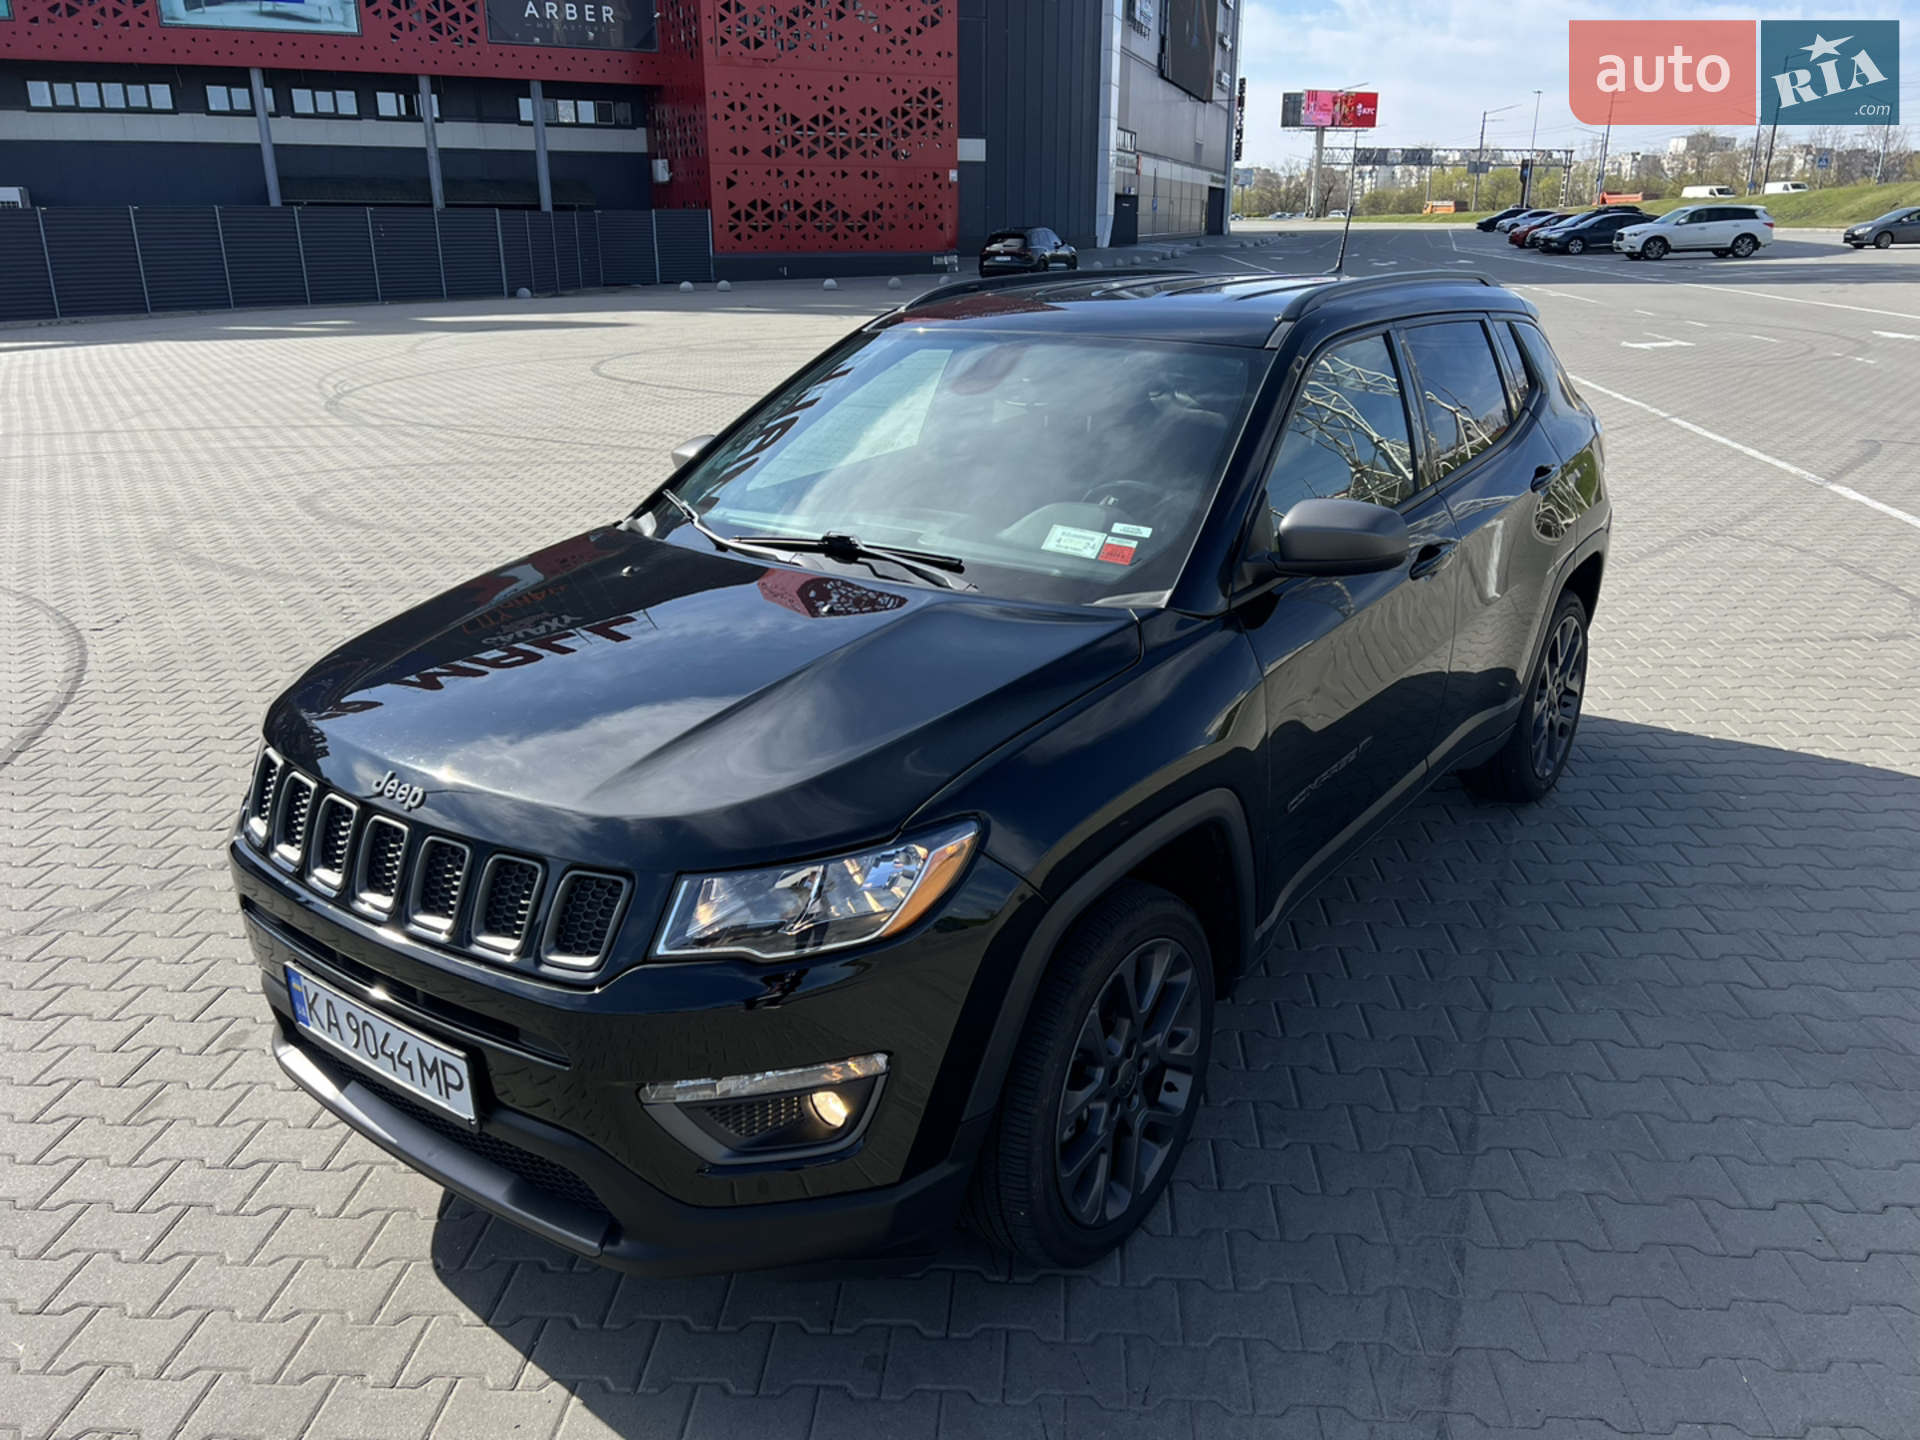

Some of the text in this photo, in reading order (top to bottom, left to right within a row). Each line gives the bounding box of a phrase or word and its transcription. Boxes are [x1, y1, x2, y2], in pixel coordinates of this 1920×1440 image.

[524, 0, 615, 24] ARBER
[536, 22, 606, 33] MEGASTORE
[1362, 107, 1376, 116] KFC
[371, 770, 426, 811] Jeep
